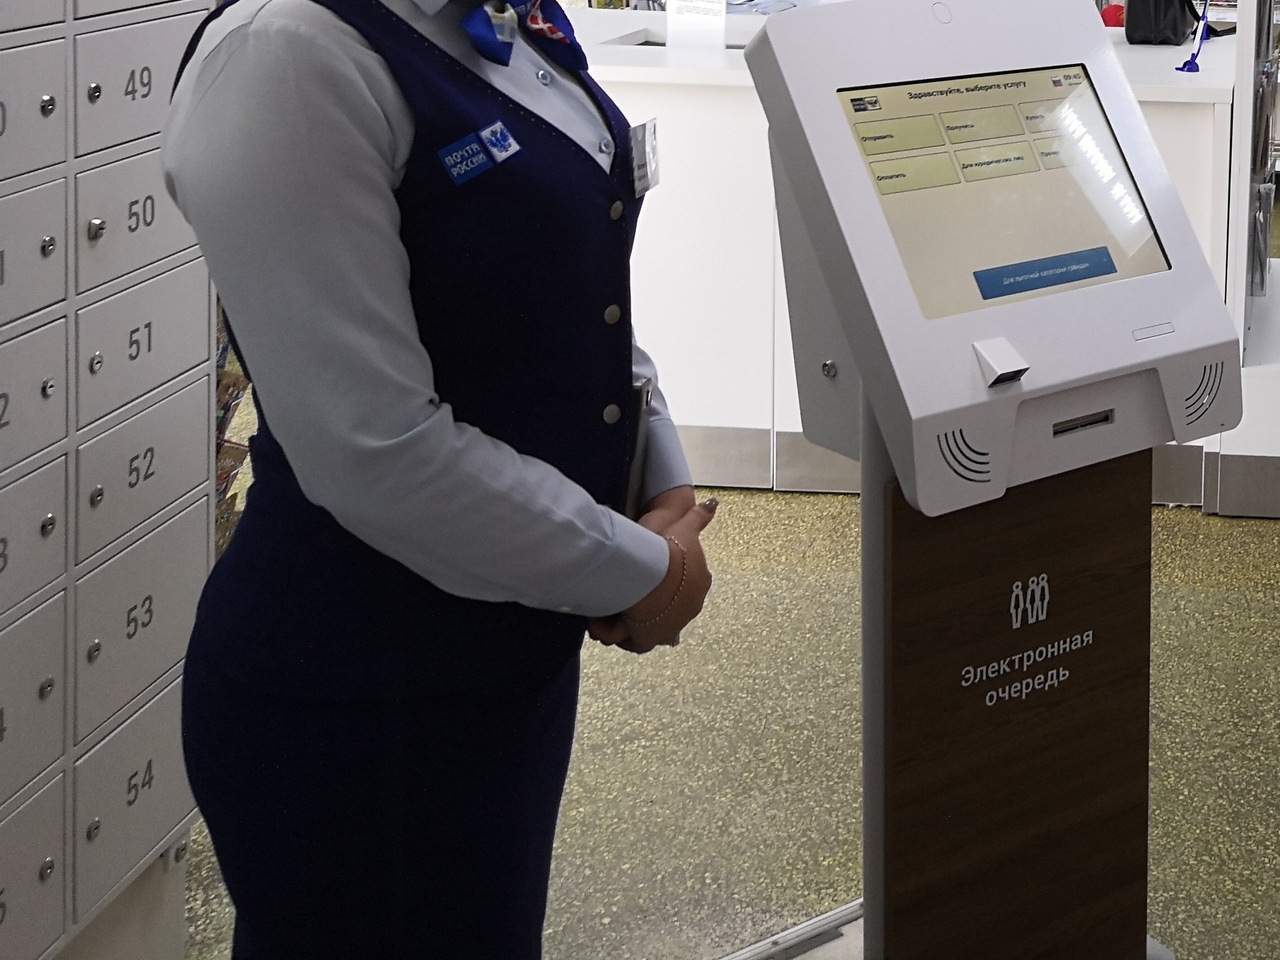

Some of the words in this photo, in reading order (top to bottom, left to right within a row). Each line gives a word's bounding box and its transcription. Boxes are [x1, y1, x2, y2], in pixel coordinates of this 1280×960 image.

[124, 66, 152, 101] 49
[445, 142, 481, 166] ПОЧТА
[451, 152, 487, 177] РОССИИ
[127, 195, 155, 233] 50
[128, 321, 152, 361] 51
[128, 446, 155, 488] 52
[126, 594, 154, 640] 53
[961, 630, 1093, 687] Электронная
[985, 666, 1070, 707] очередь
[126, 758, 154, 807] 54
